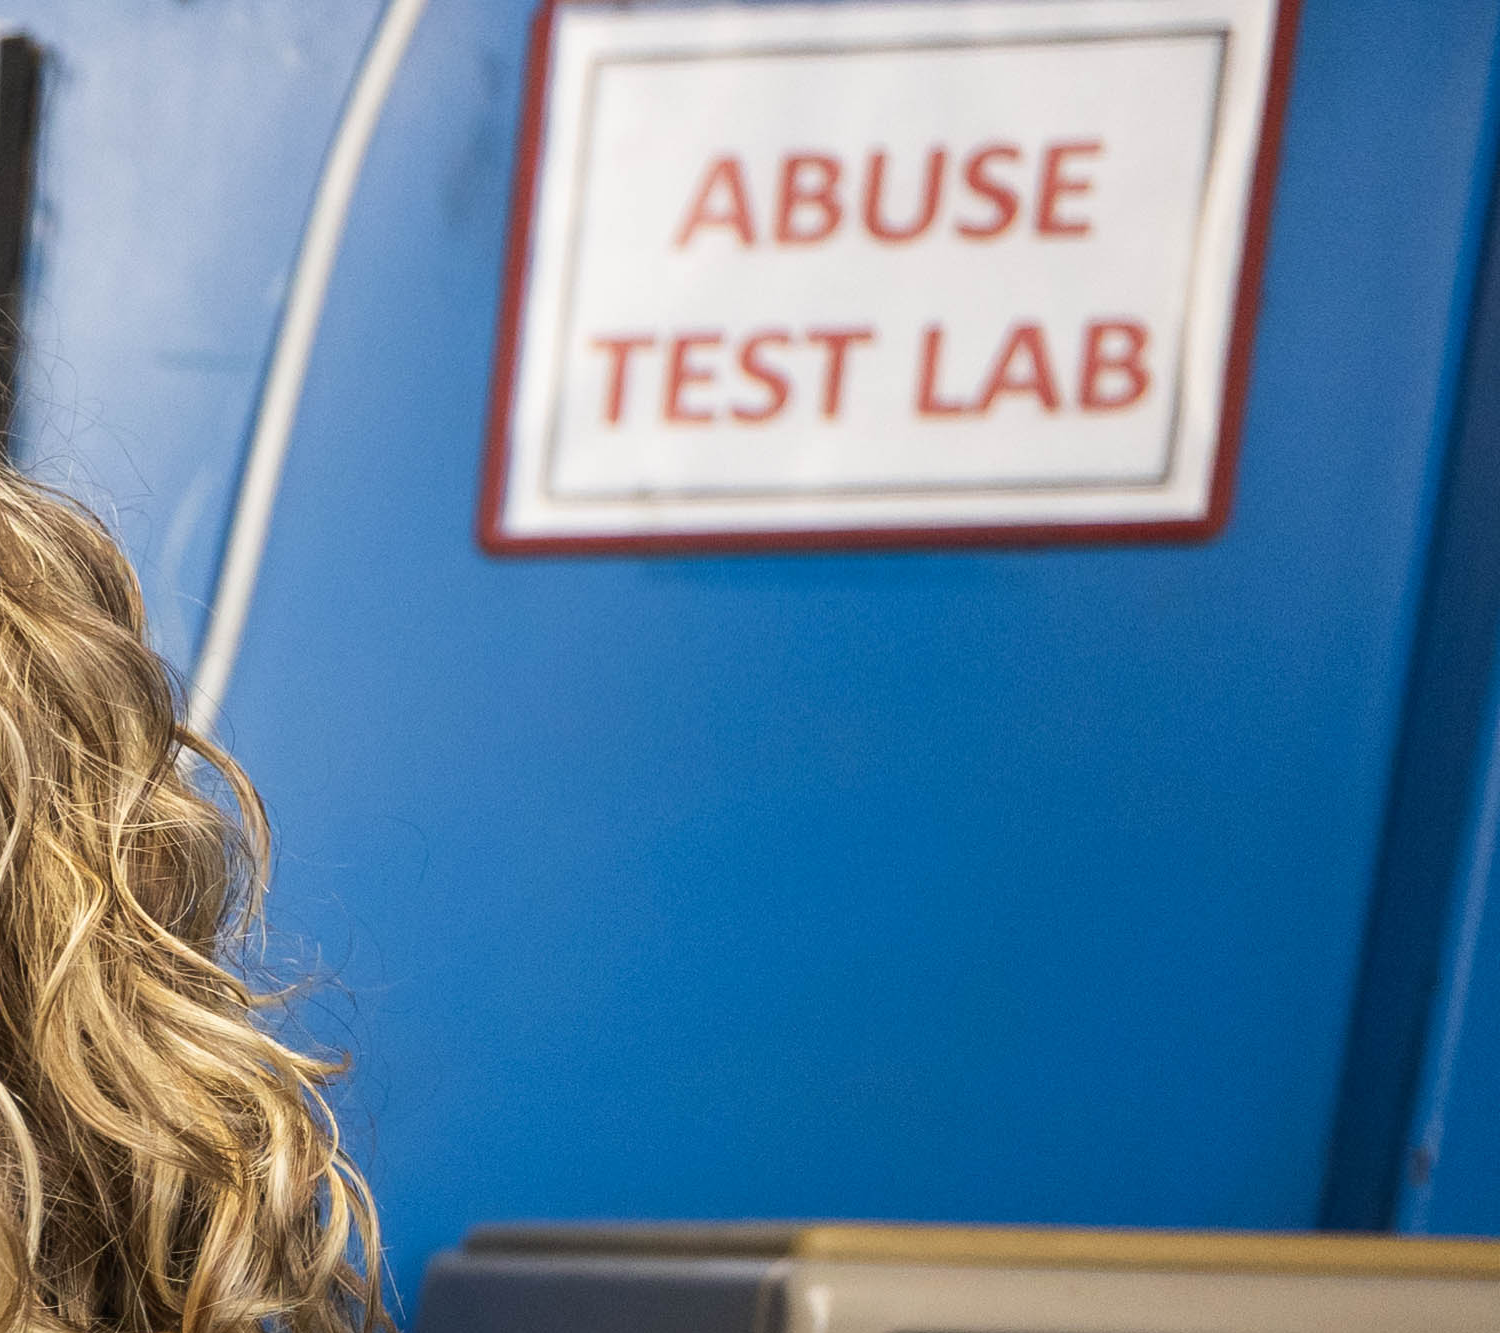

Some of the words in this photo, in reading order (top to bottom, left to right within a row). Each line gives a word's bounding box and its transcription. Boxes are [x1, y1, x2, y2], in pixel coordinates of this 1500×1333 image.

[673, 139, 1105, 249] ABUSE
[591, 325, 874, 428] TEST
[913, 318, 1154, 420] LAB
